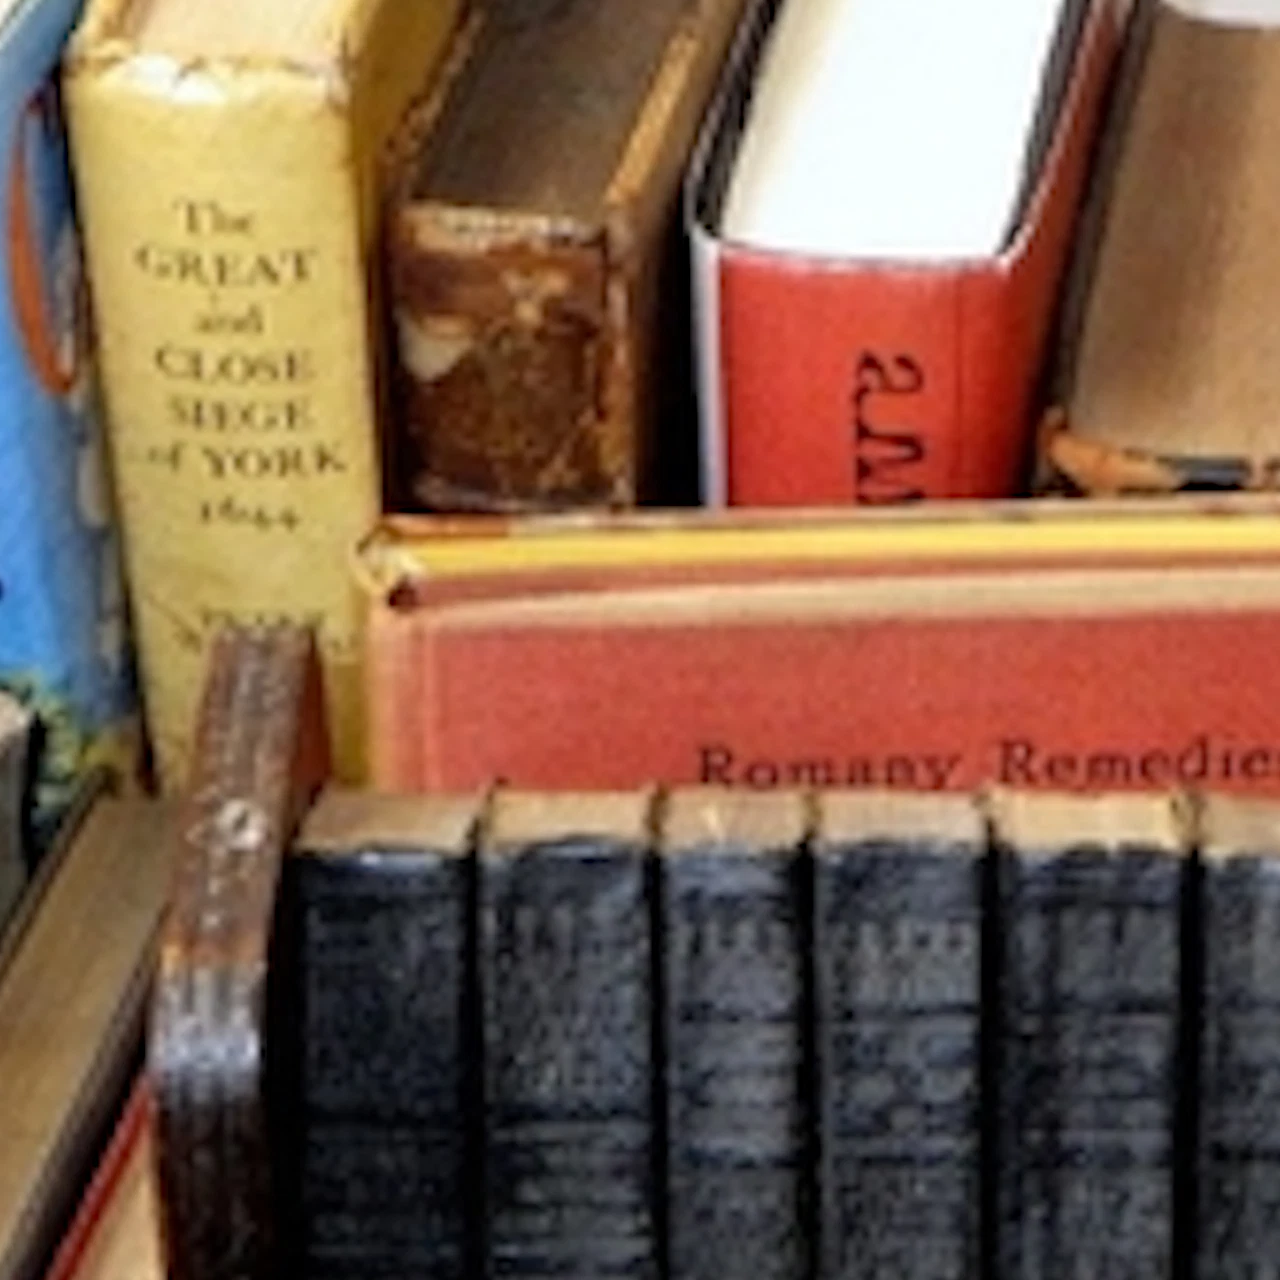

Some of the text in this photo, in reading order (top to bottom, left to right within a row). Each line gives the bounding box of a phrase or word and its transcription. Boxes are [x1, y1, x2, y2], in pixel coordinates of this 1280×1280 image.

[170, 196, 254, 236] The
[132, 242, 320, 288] GREAT
[192, 300, 266, 336] and
[154, 344, 320, 386] CLOSE
[166, 396, 320, 434] SIEGE
[202, 442, 350, 480] YORK
[696, 742, 960, 790] Romany
